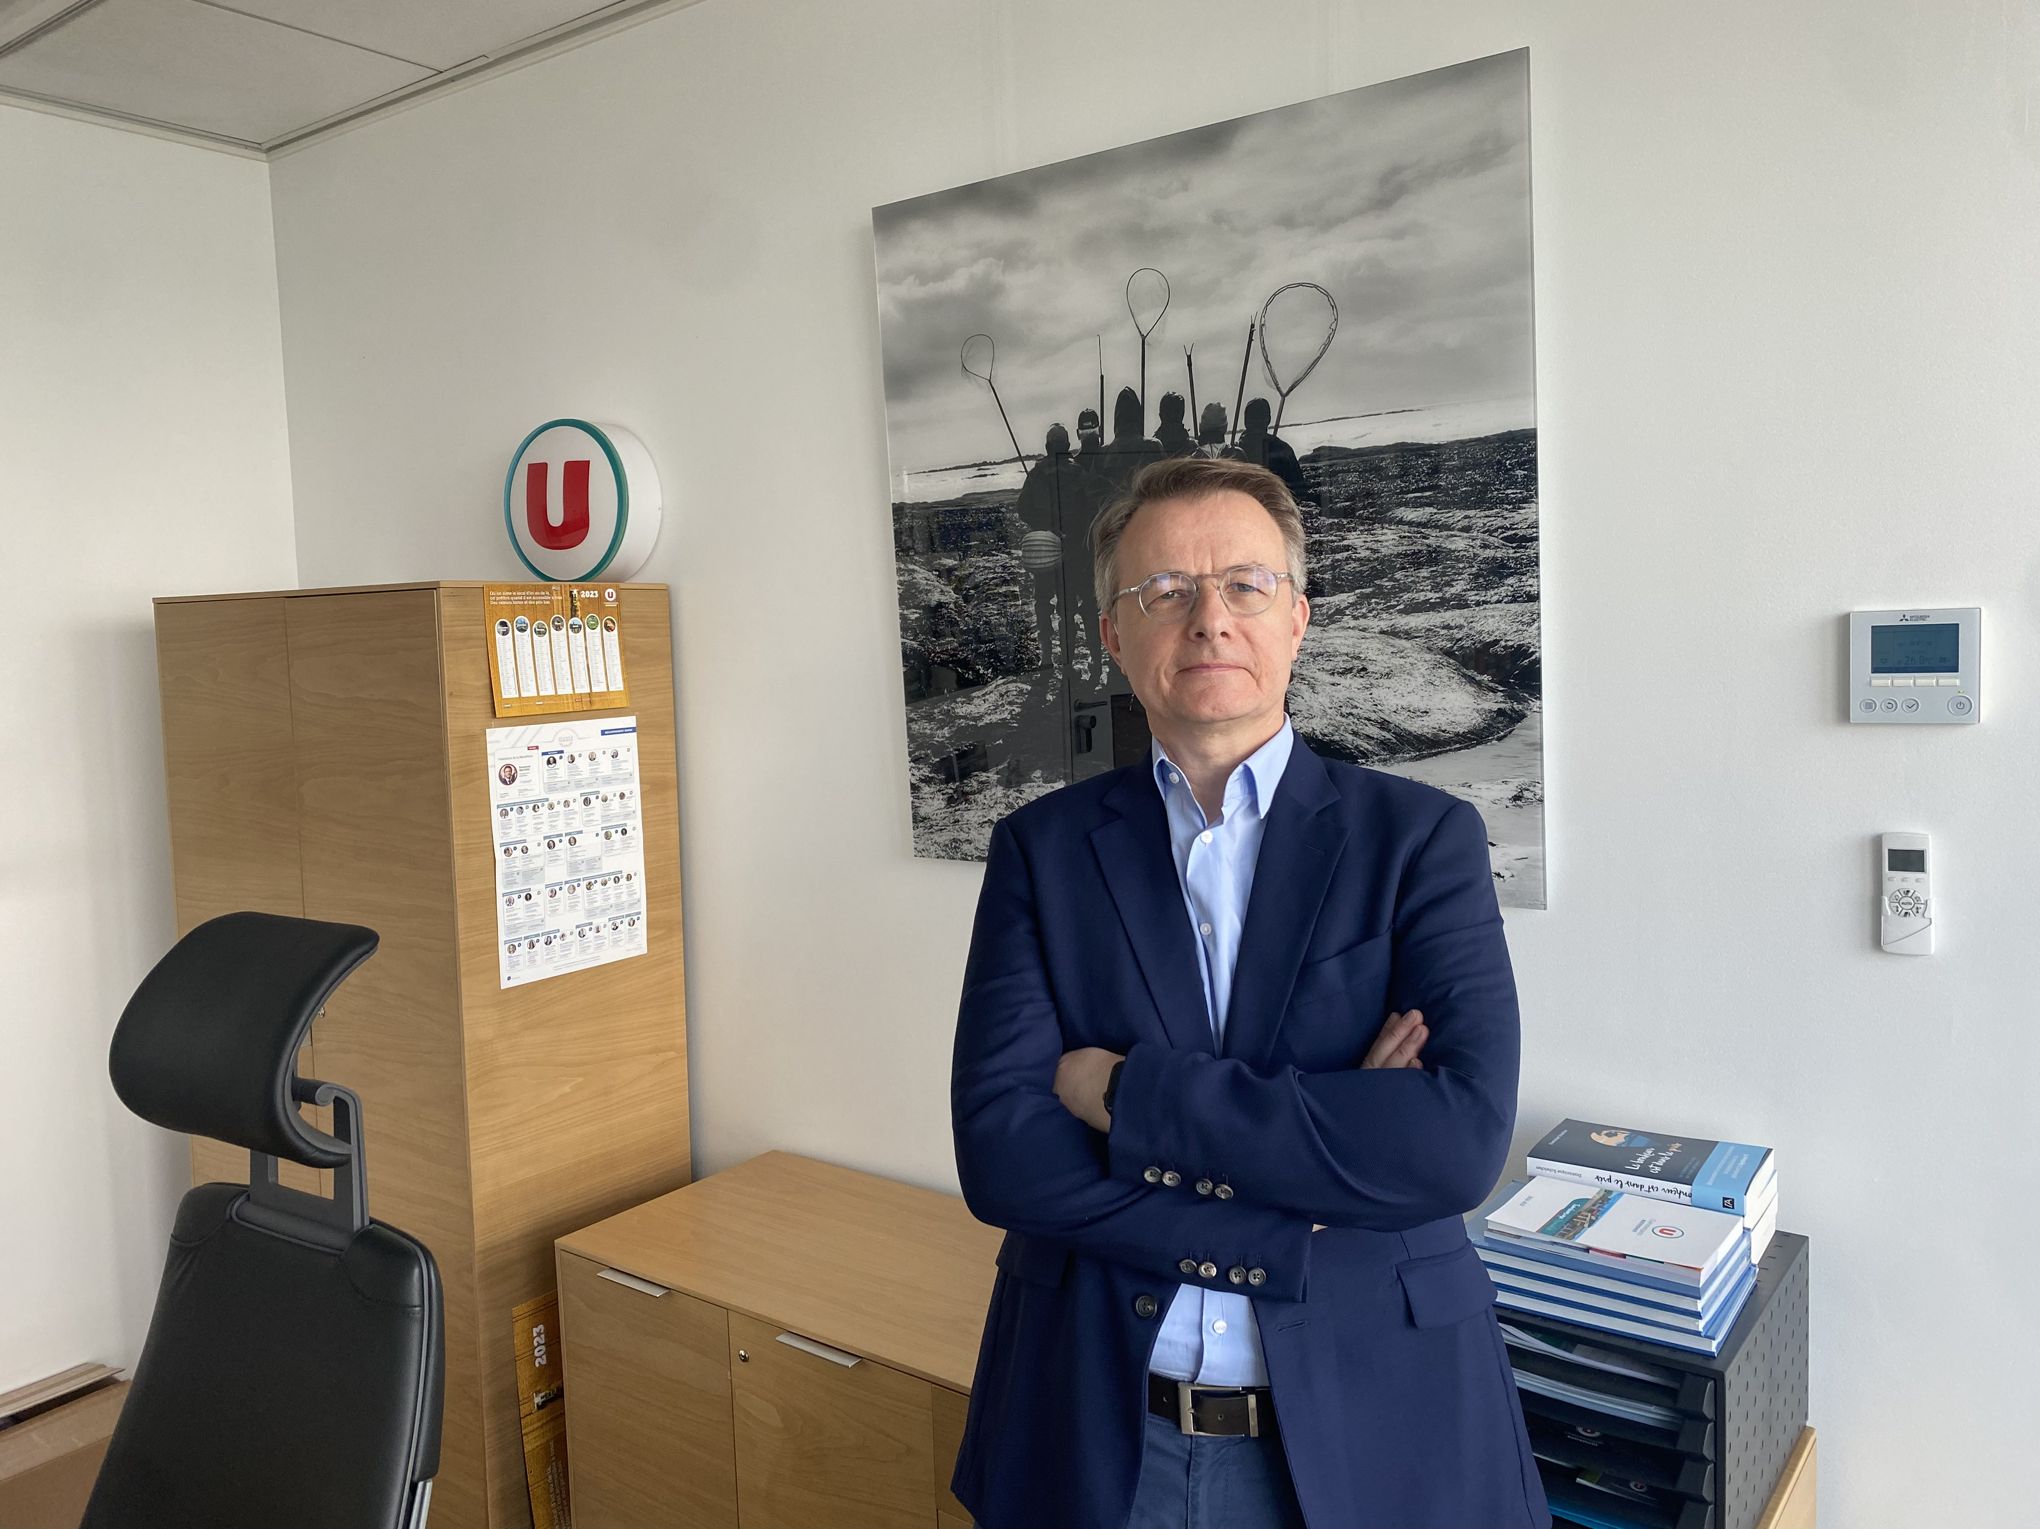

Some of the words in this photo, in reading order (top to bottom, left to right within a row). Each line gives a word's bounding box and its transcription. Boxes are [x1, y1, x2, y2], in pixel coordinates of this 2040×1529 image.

[526, 460, 591, 551] U
[580, 590, 599, 598] 2023
[1614, 1179, 1624, 1189] le
[1625, 1180, 1645, 1192] dans
[1662, 1187, 1693, 1199] onheur
[532, 1324, 547, 1368] 2023
